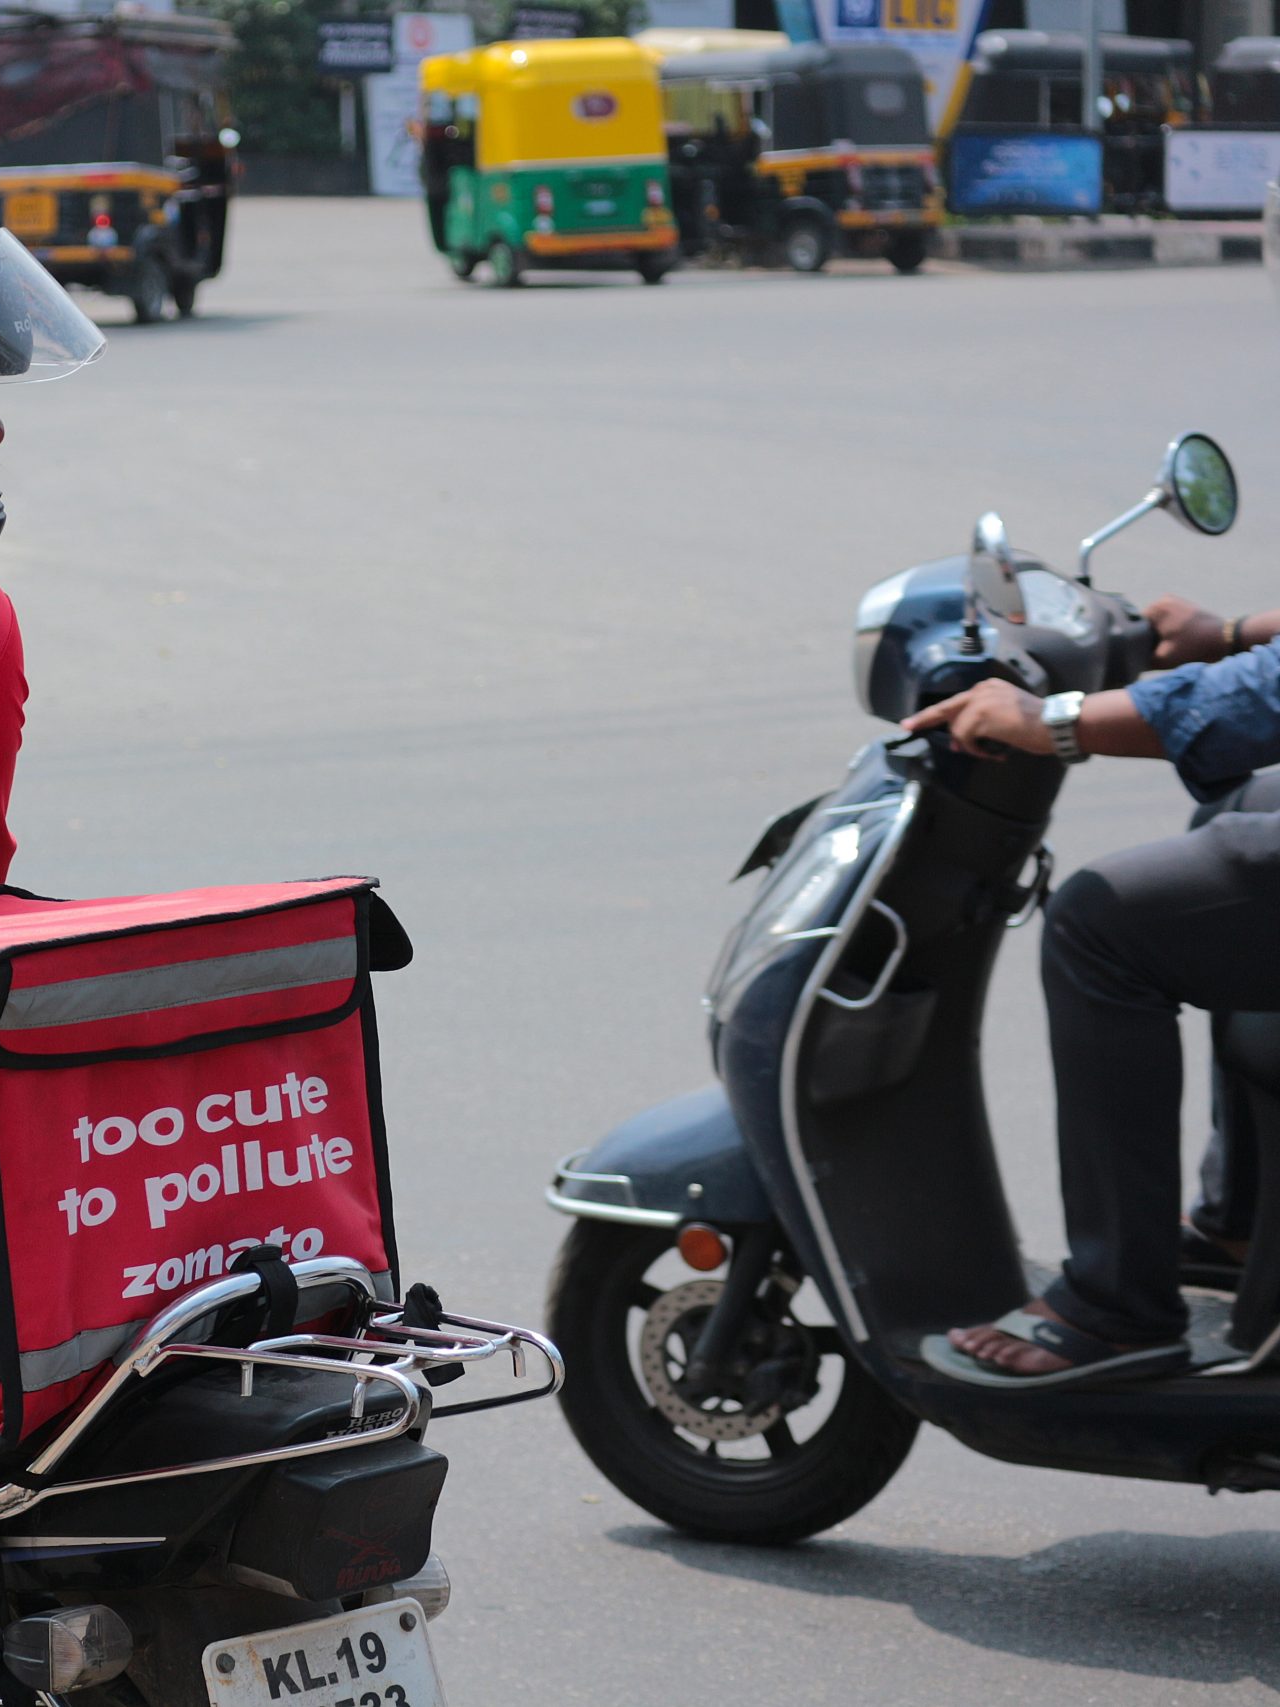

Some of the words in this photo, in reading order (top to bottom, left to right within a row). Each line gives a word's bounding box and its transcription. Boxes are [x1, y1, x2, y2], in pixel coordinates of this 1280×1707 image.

[73, 1107, 185, 1163] too
[195, 1072, 329, 1133] cute
[58, 1187, 117, 1235] to
[144, 1134, 354, 1229] pollute
[348, 1407, 404, 1429] HERO
[262, 1631, 387, 1700] KL.19
